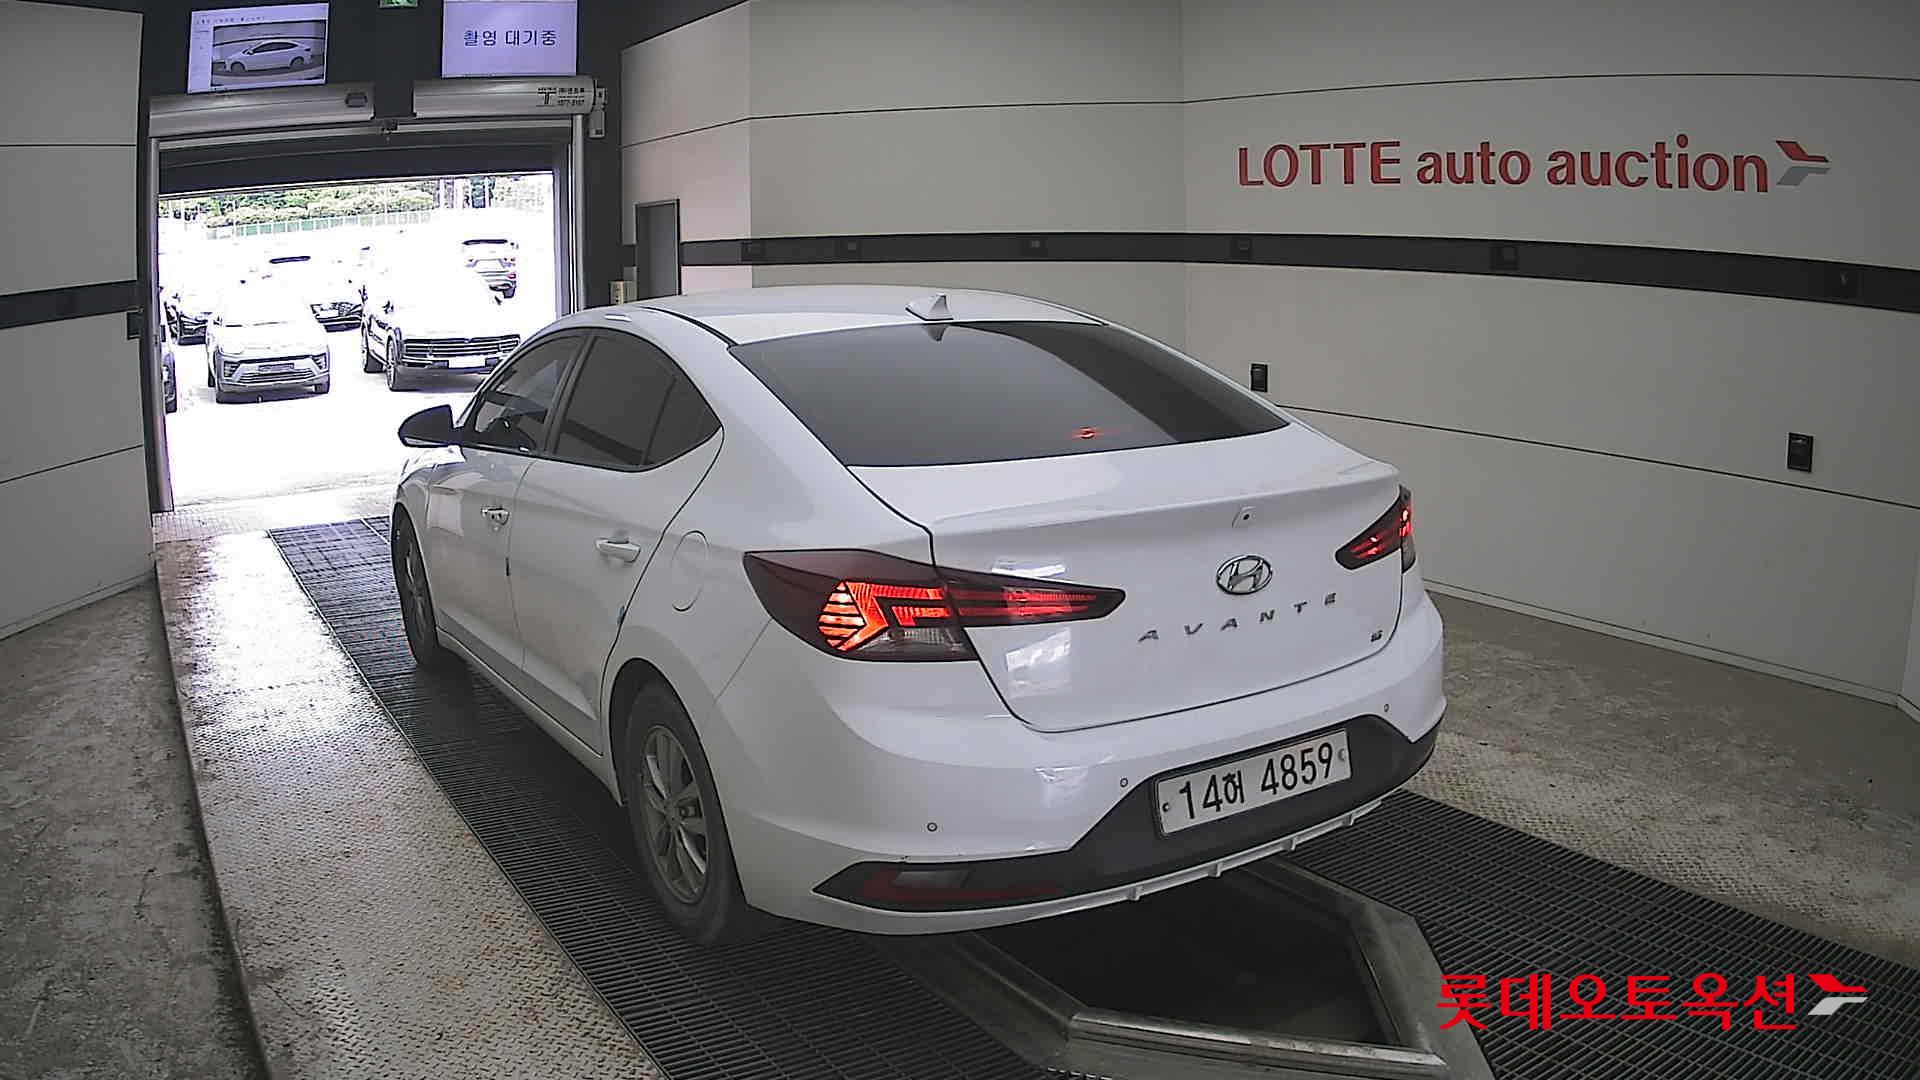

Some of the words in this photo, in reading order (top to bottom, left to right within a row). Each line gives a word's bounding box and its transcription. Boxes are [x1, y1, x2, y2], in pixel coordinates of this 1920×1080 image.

[505, 29, 557, 47] 대기중
[1238, 140, 1401, 187] LOTTE
[1417, 140, 1532, 186] auto
[1547, 134, 1769, 193] auction
[1138, 592, 1337, 643] AVANTE
[1179, 770, 1246, 820] 14허
[1260, 742, 1334, 796] 4859
